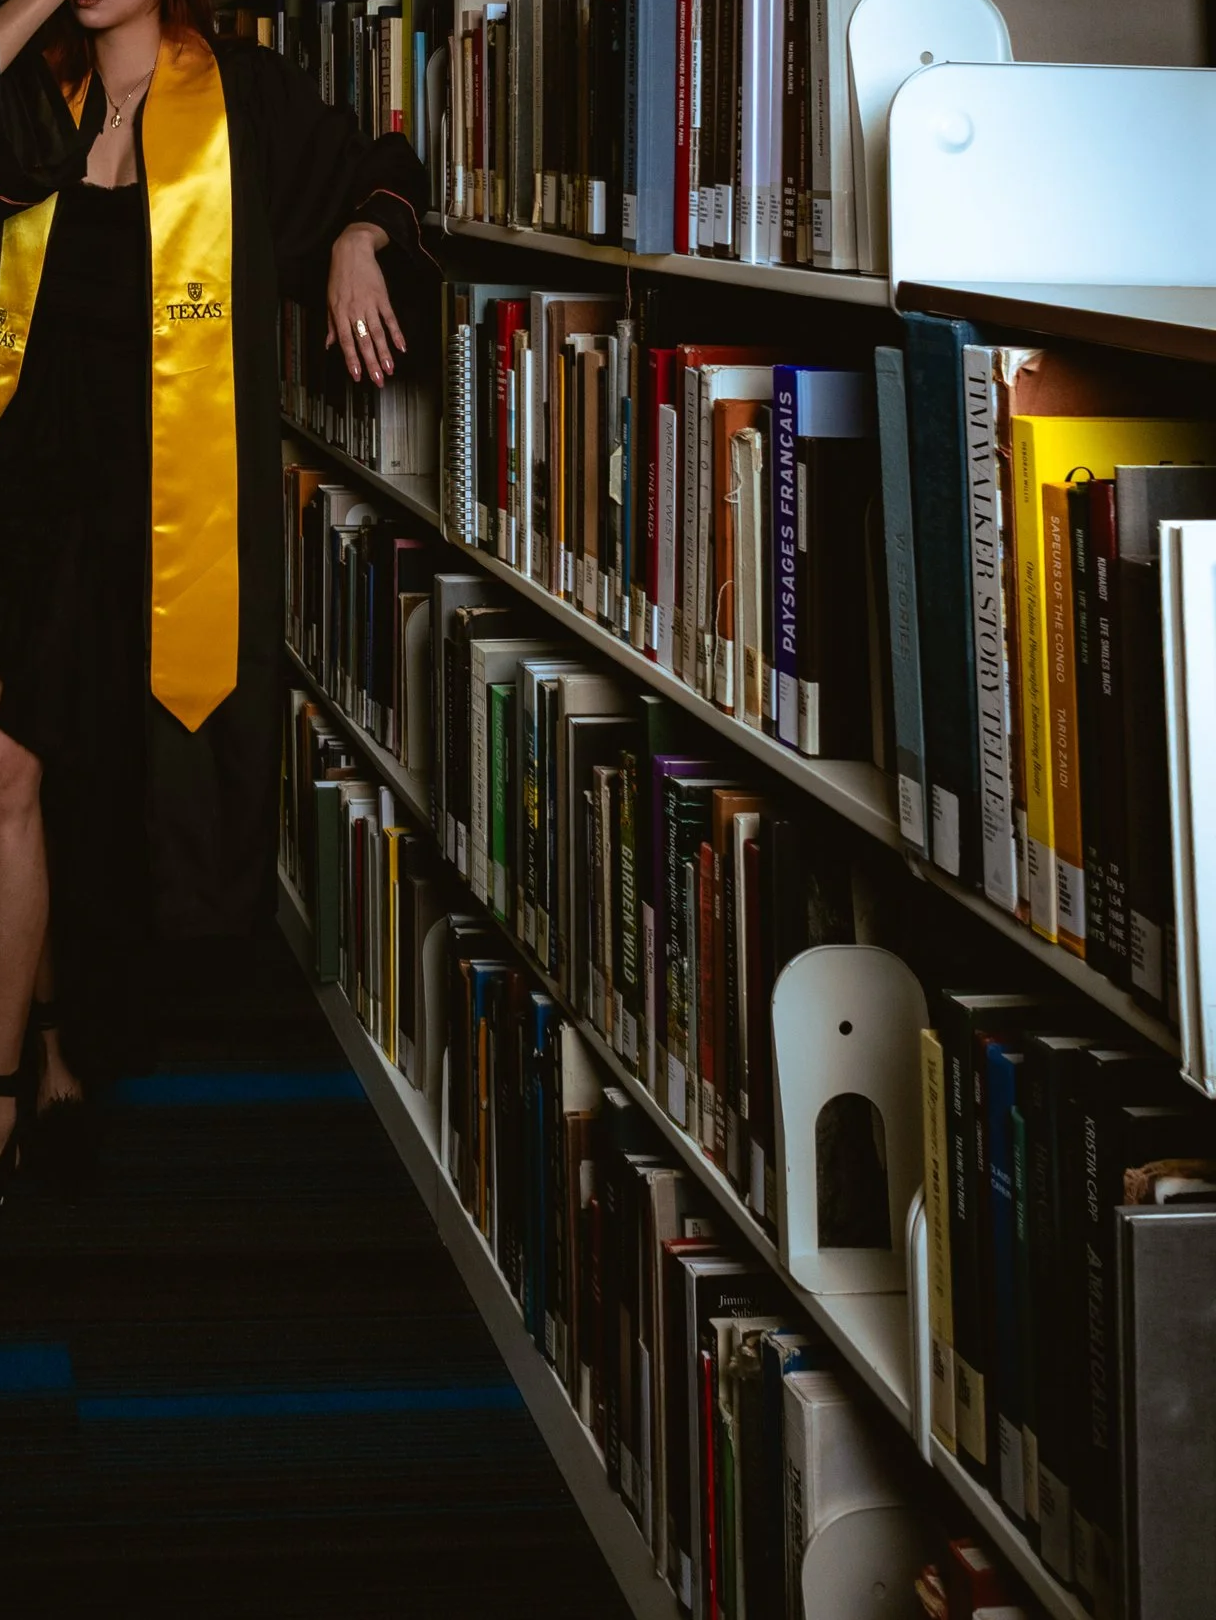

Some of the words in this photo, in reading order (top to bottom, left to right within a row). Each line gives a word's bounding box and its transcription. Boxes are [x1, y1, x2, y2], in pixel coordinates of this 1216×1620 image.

[678, 0, 687, 29] AMERICAN
[678, 29, 687, 74] PHOTOGRAPHERS
[787, 40, 795, 64] TAKING
[678, 74, 686, 87] AND
[678, 87, 686, 100] THE
[787, 64, 795, 95] MEASURES
[817, 78, 825, 103] French
[677, 99, 686, 125] NATIONAL
[817, 104, 827, 157] Landscapes
[677, 127, 685, 146] PARKS
[167, 303, 224, 321] TEXAS
[968, 370, 988, 428] TIM
[664, 420, 674, 501] MAGNETIC
[779, 390, 796, 518] FRANÇAIS
[1021, 440, 1029, 477] DEBORAH
[647, 460, 656, 540] VINEYARDS
[972, 439, 994, 580] WALKER
[1022, 478, 1030, 504] WILLIS
[664, 506, 675, 543] WEST
[686, 533, 697, 573] ERIC
[1050, 515, 1063, 577] SAPEURS
[1076, 528, 1086, 573] KUNHARDT
[779, 525, 798, 656] PAYSAGES
[1053, 580, 1063, 598] OF
[1097, 556, 1109, 602] KUNHARDT
[1027, 596, 1039, 635] Fashion
[1054, 603, 1064, 629] THE
[1078, 590, 1087, 609] LIFE
[977, 591, 999, 700] STORY
[1079, 611, 1088, 641] SMILES
[1099, 616, 1110, 637] LIFE
[1055, 633, 1066, 683] CONGO
[1080, 643, 1089, 664] BACK
[1100, 639, 1111, 670] SMILES
[1102, 671, 1112, 696] BACK
[494, 700, 504, 749] SENSE
[1056, 707, 1068, 750] TARIQ
[495, 748, 504, 764] OF
[527, 732, 536, 765] THE
[495, 763, 504, 813] PLACE
[1058, 752, 1069, 788] ZAIDI
[527, 767, 537, 830] HUMAN
[666, 791, 678, 817] The
[527, 832, 537, 898] PLANET
[594, 826, 603, 869] LANKA
[666, 820, 680, 914] Photographer
[621, 843, 636, 927] GARDEN
[1108, 862, 1120, 876] TR
[670, 936, 680, 958] the
[1107, 921, 1126, 942] FINE
[1107, 938, 1127, 957] ARTS
[622, 931, 637, 985] WILD
[670, 960, 681, 1012] Garden
[953, 1056, 964, 1117] BURCKHARDT
[955, 1133, 965, 1172] TALKING
[1083, 1115, 1099, 1179] KRISTIN
[957, 1174, 967, 1220] PICTURES
[1086, 1181, 1100, 1223] CAPP
[1086, 1242, 1109, 1451] AMERICANA
